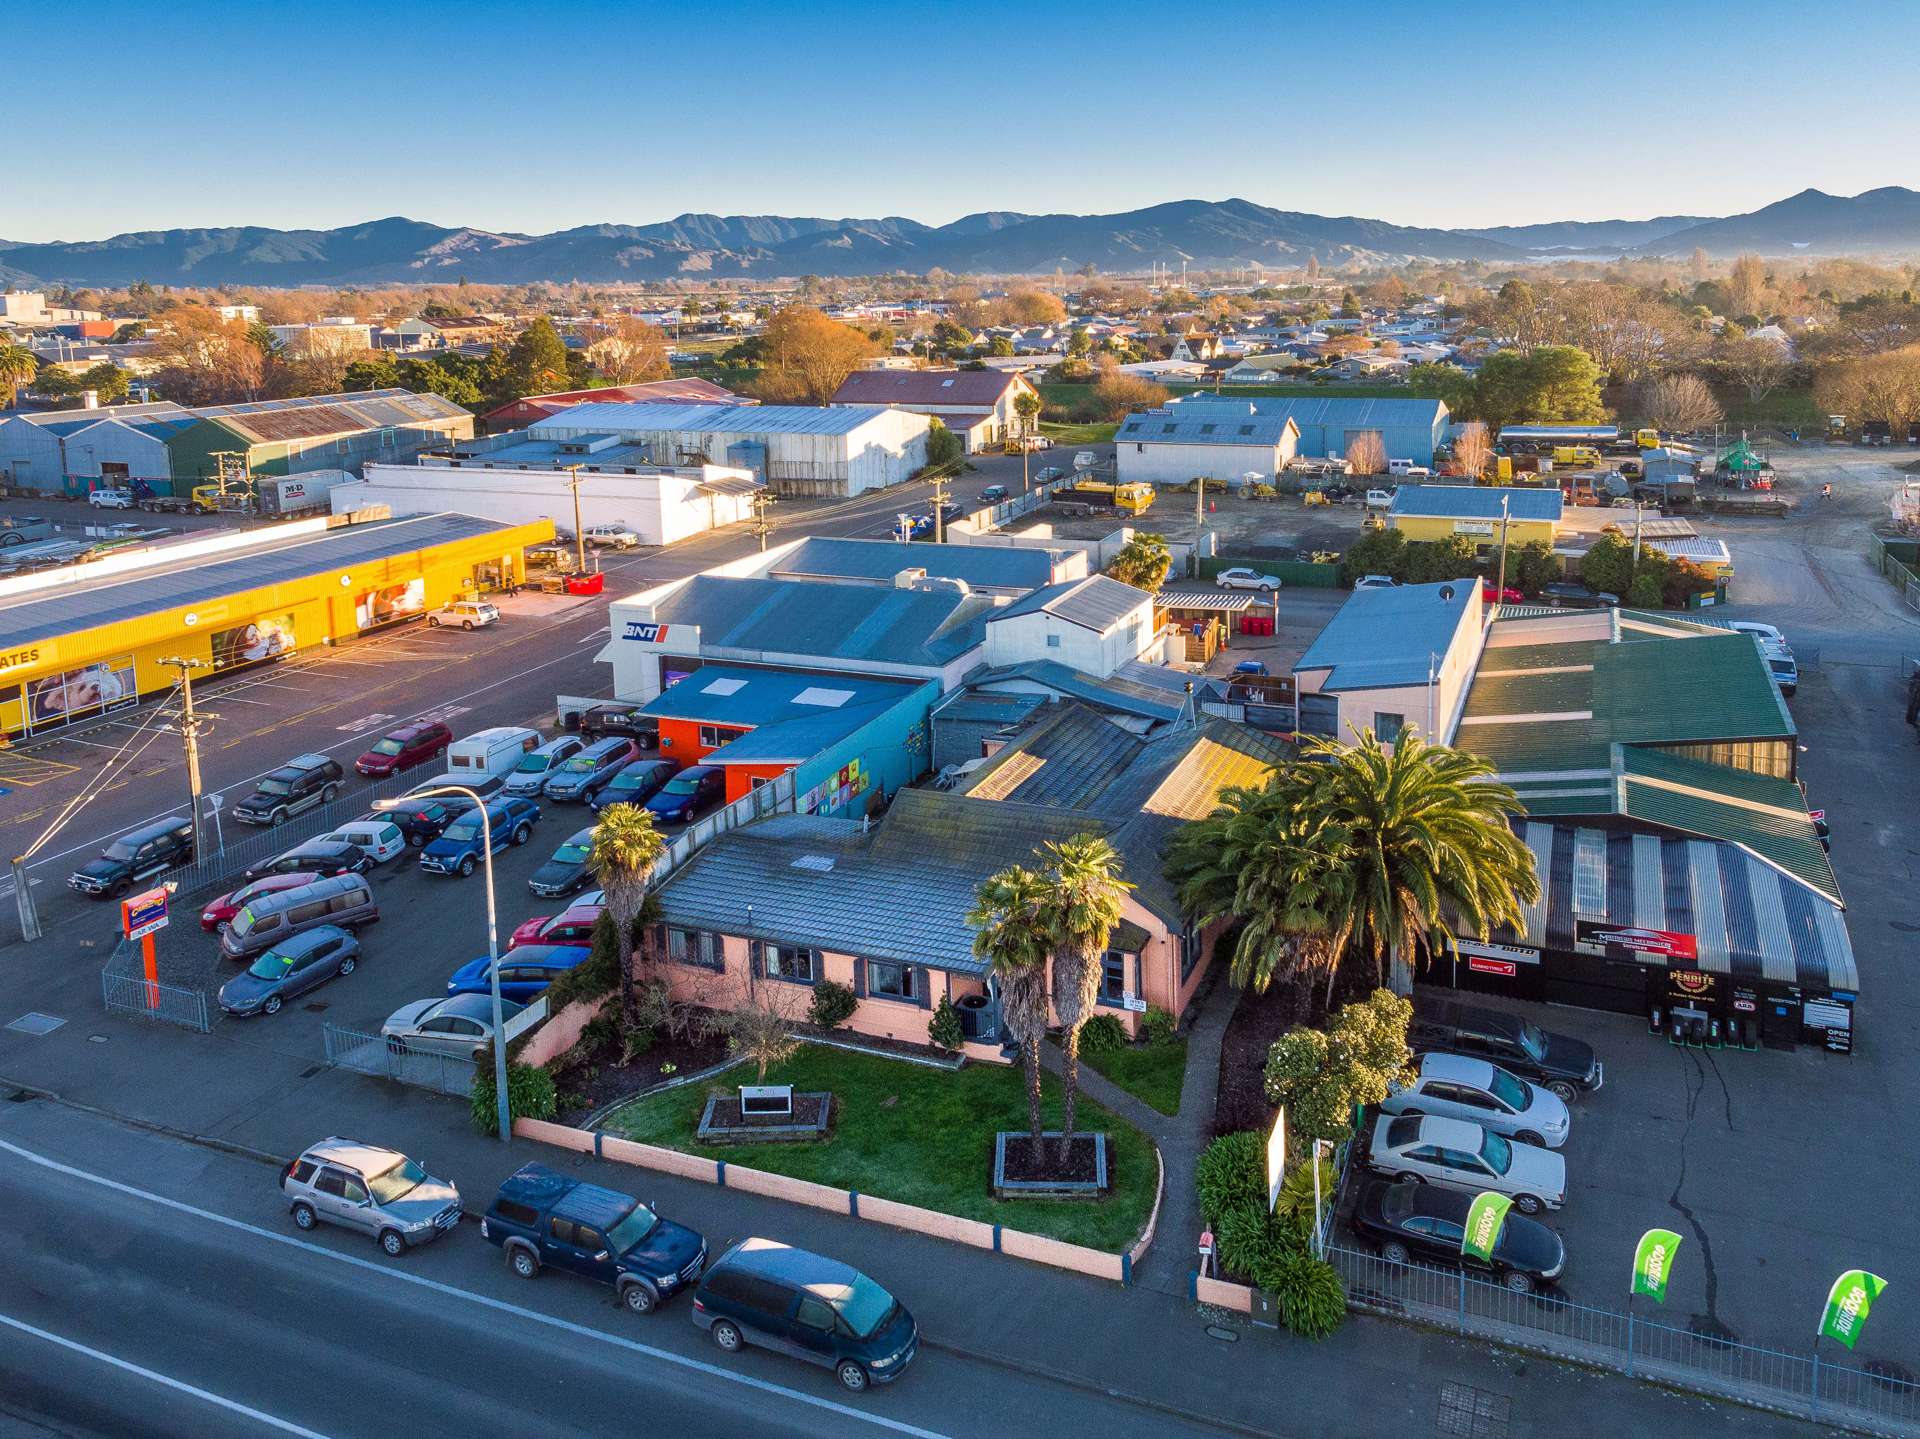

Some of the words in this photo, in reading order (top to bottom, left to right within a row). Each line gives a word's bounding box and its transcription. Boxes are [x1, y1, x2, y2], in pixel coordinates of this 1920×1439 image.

[625, 625, 658, 638] BNT
[1669, 969, 1715, 986] PENRITE
[1828, 1029, 1850, 1038] OPEN
[1475, 1206, 1497, 1252] GOODRIDE
[1647, 1244, 1665, 1291] GOODRIDE
